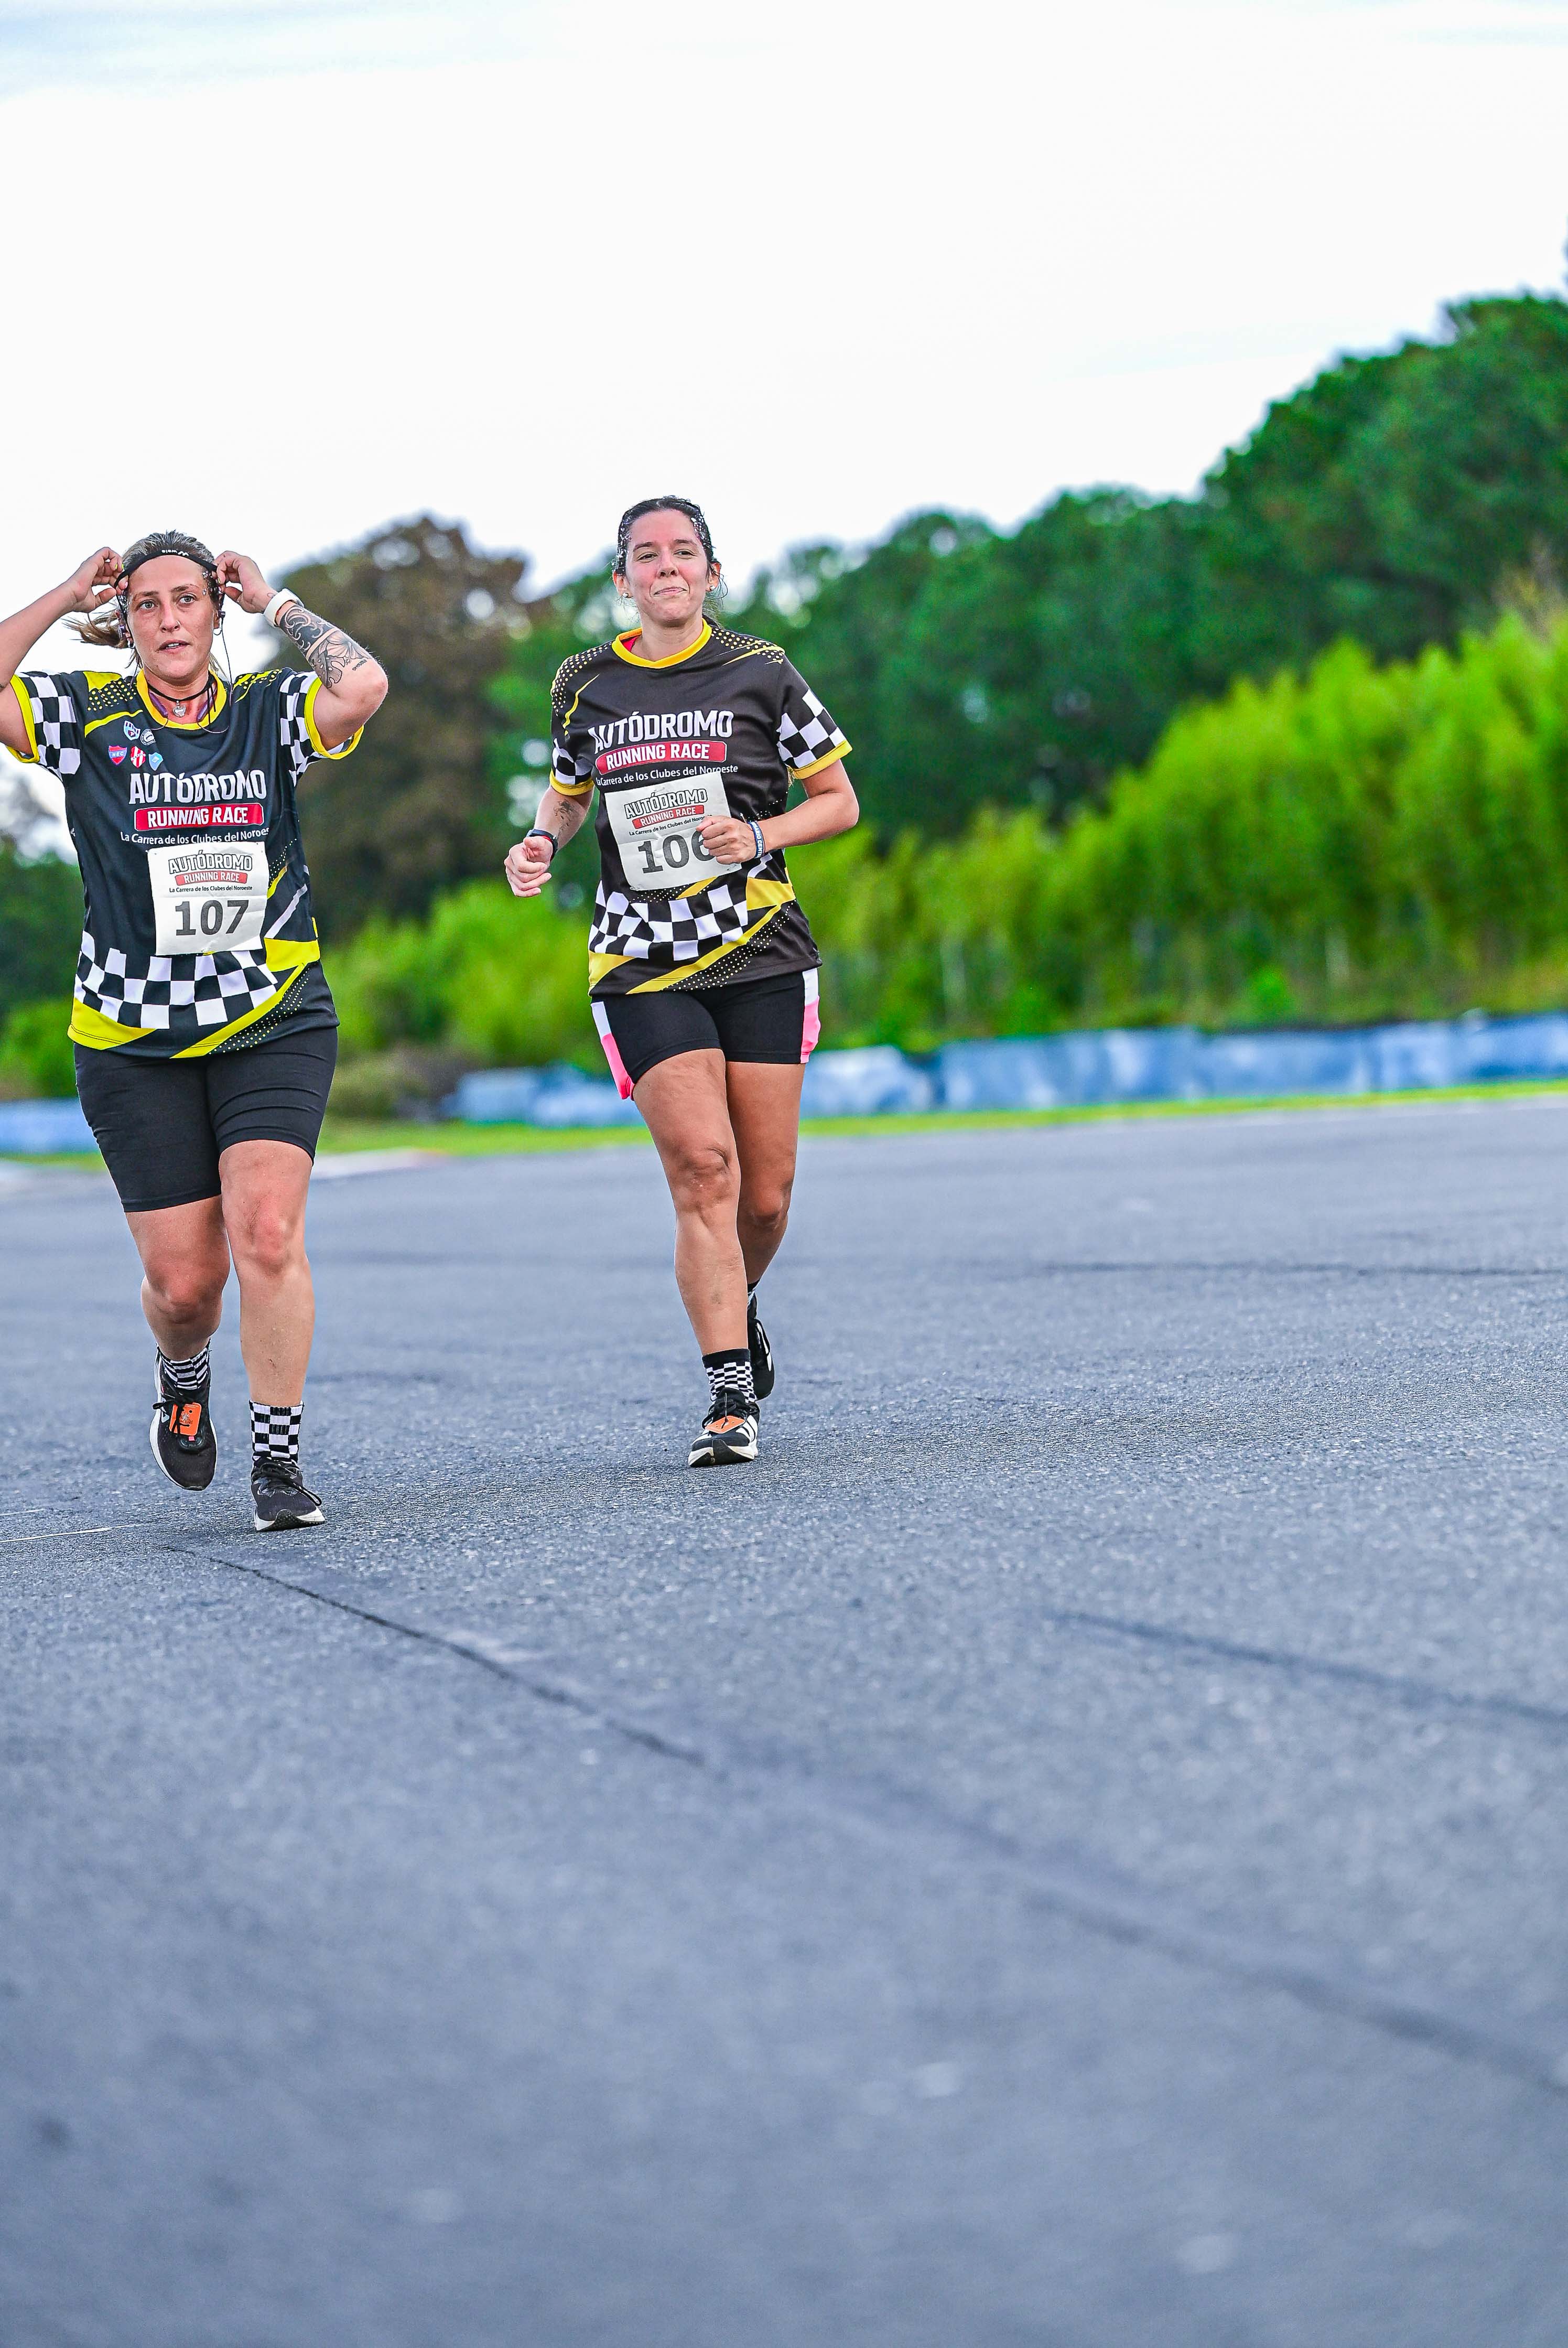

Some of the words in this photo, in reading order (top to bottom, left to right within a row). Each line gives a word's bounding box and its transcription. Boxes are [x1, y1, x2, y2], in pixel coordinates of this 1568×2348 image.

[587, 710, 734, 754] AUTÓDROMO
[605, 745, 666, 770] RUNNING
[670, 743, 710, 759] RACE
[129, 769, 267, 804] AUTÓDROMO
[601, 777, 622, 786] Carrera
[623, 773, 634, 783] de
[635, 772, 649, 781] los
[650, 768, 681, 779] Clubes
[683, 766, 697, 776] del
[699, 764, 739, 774] Noroeste
[624, 788, 708, 819] AUTÓDROMO
[147, 807, 209, 828] RUNNING
[212, 806, 248, 824] RACE
[640, 810, 674, 827] RUNNING
[675, 807, 696, 817] RACE
[120, 831, 130, 842] La
[131, 833, 164, 845] Carrera
[165, 835, 176, 844] de
[178, 835, 189, 844] los
[191, 834, 222, 844] Clubes
[224, 832, 239, 842] del
[168, 849, 253, 875] AUTÓDROMO
[637, 830, 715, 874] 106
[183, 871, 219, 884] RUNNING
[220, 871, 240, 882] RACE
[175, 899, 249, 936] 107
